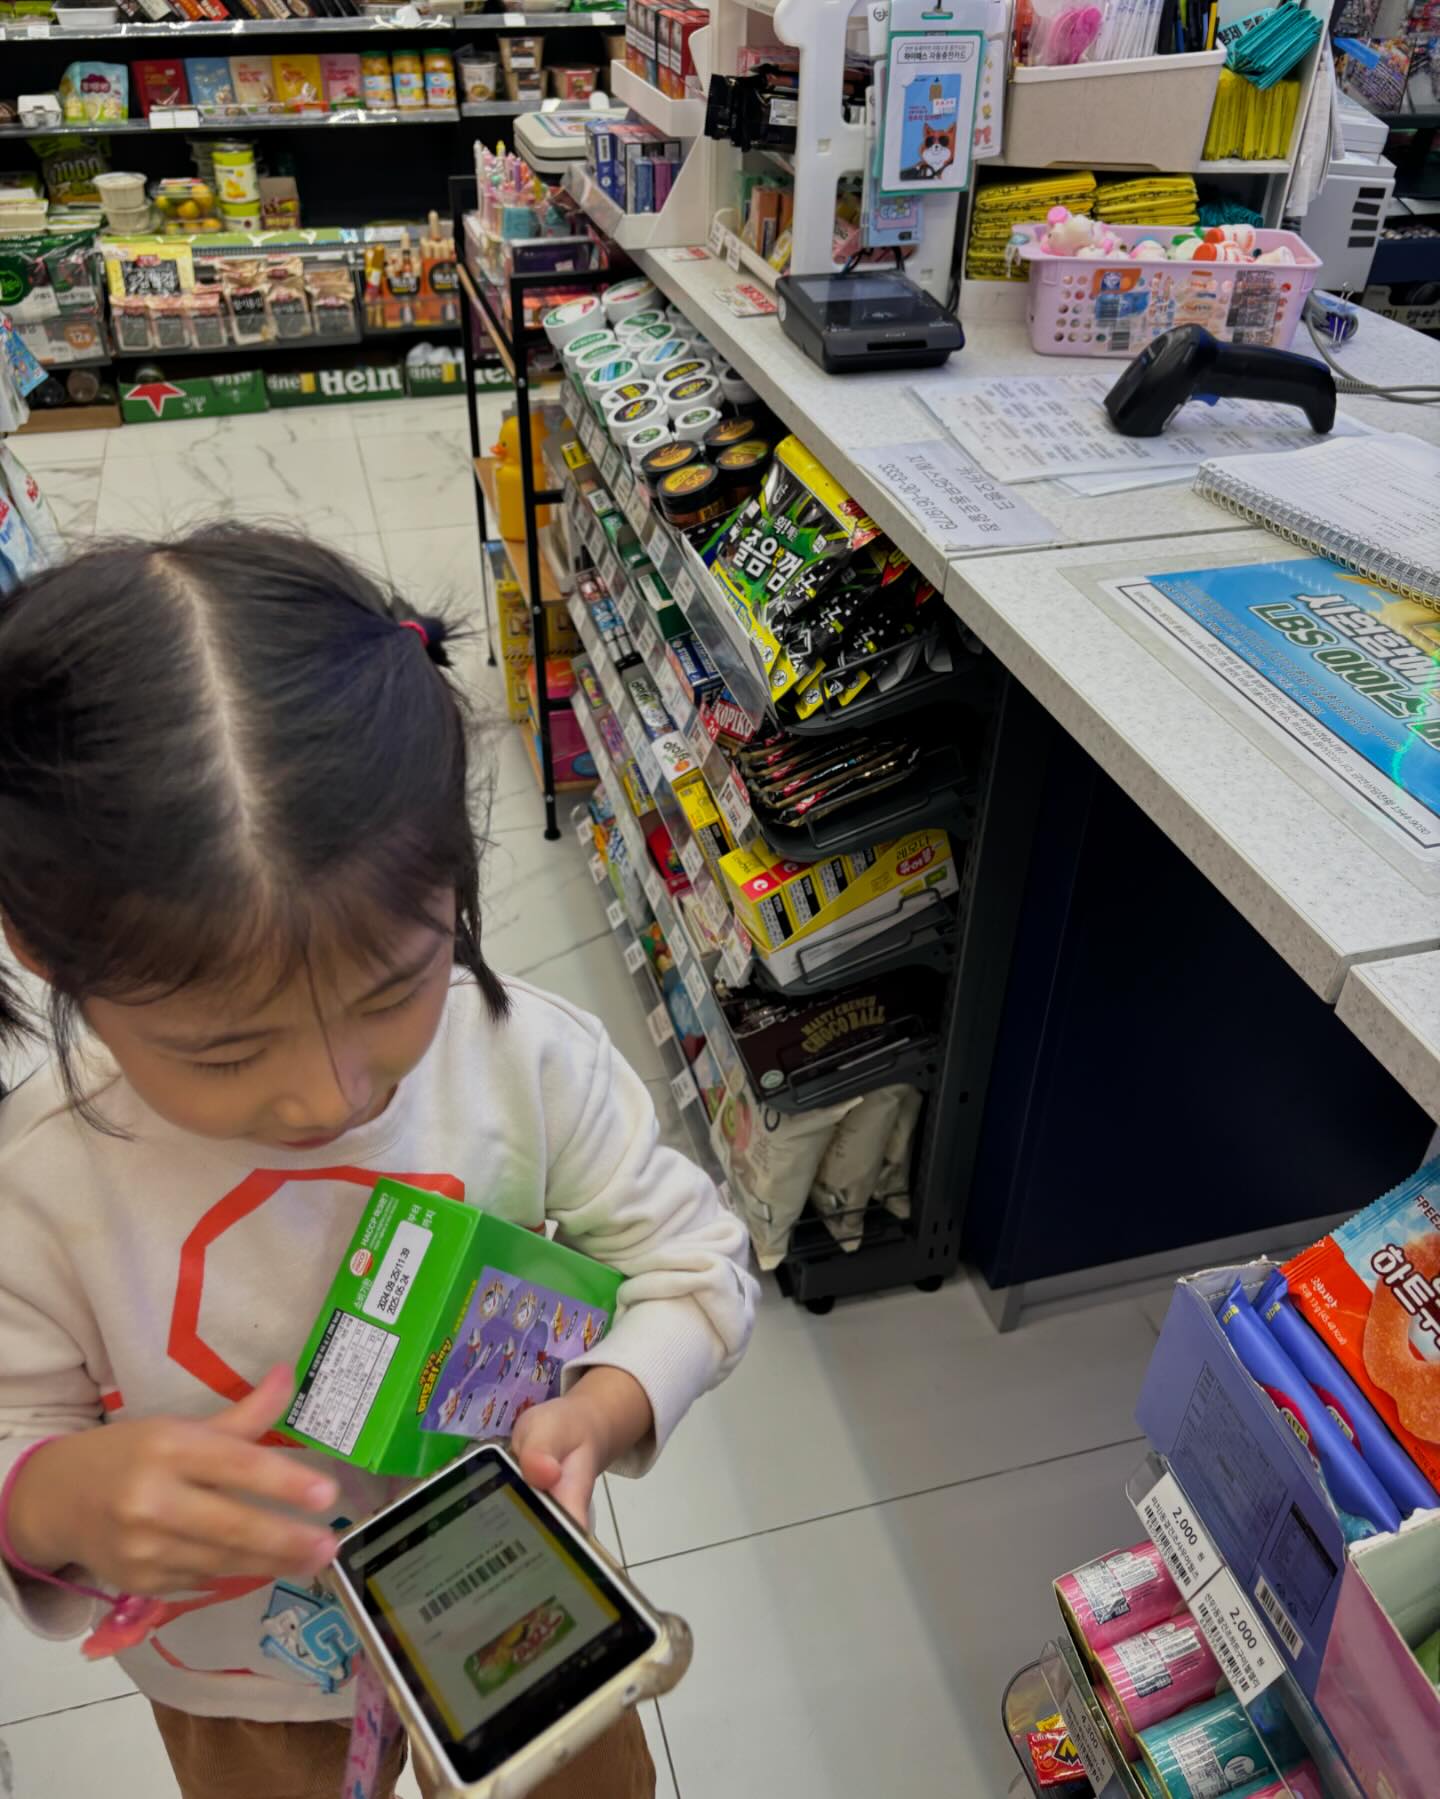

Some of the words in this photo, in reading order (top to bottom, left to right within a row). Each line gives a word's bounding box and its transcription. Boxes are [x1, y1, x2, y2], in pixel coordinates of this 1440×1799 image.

[955, 466, 1016, 511] 카카오뱅크
[1248, 602, 1340, 649] LBS
[1312, 647, 1431, 719] 아이스
[849, 1005, 887, 1031] BALL
[1171, 1506, 1199, 1546] 2,000
[1228, 1606, 1258, 1650] 2,000
